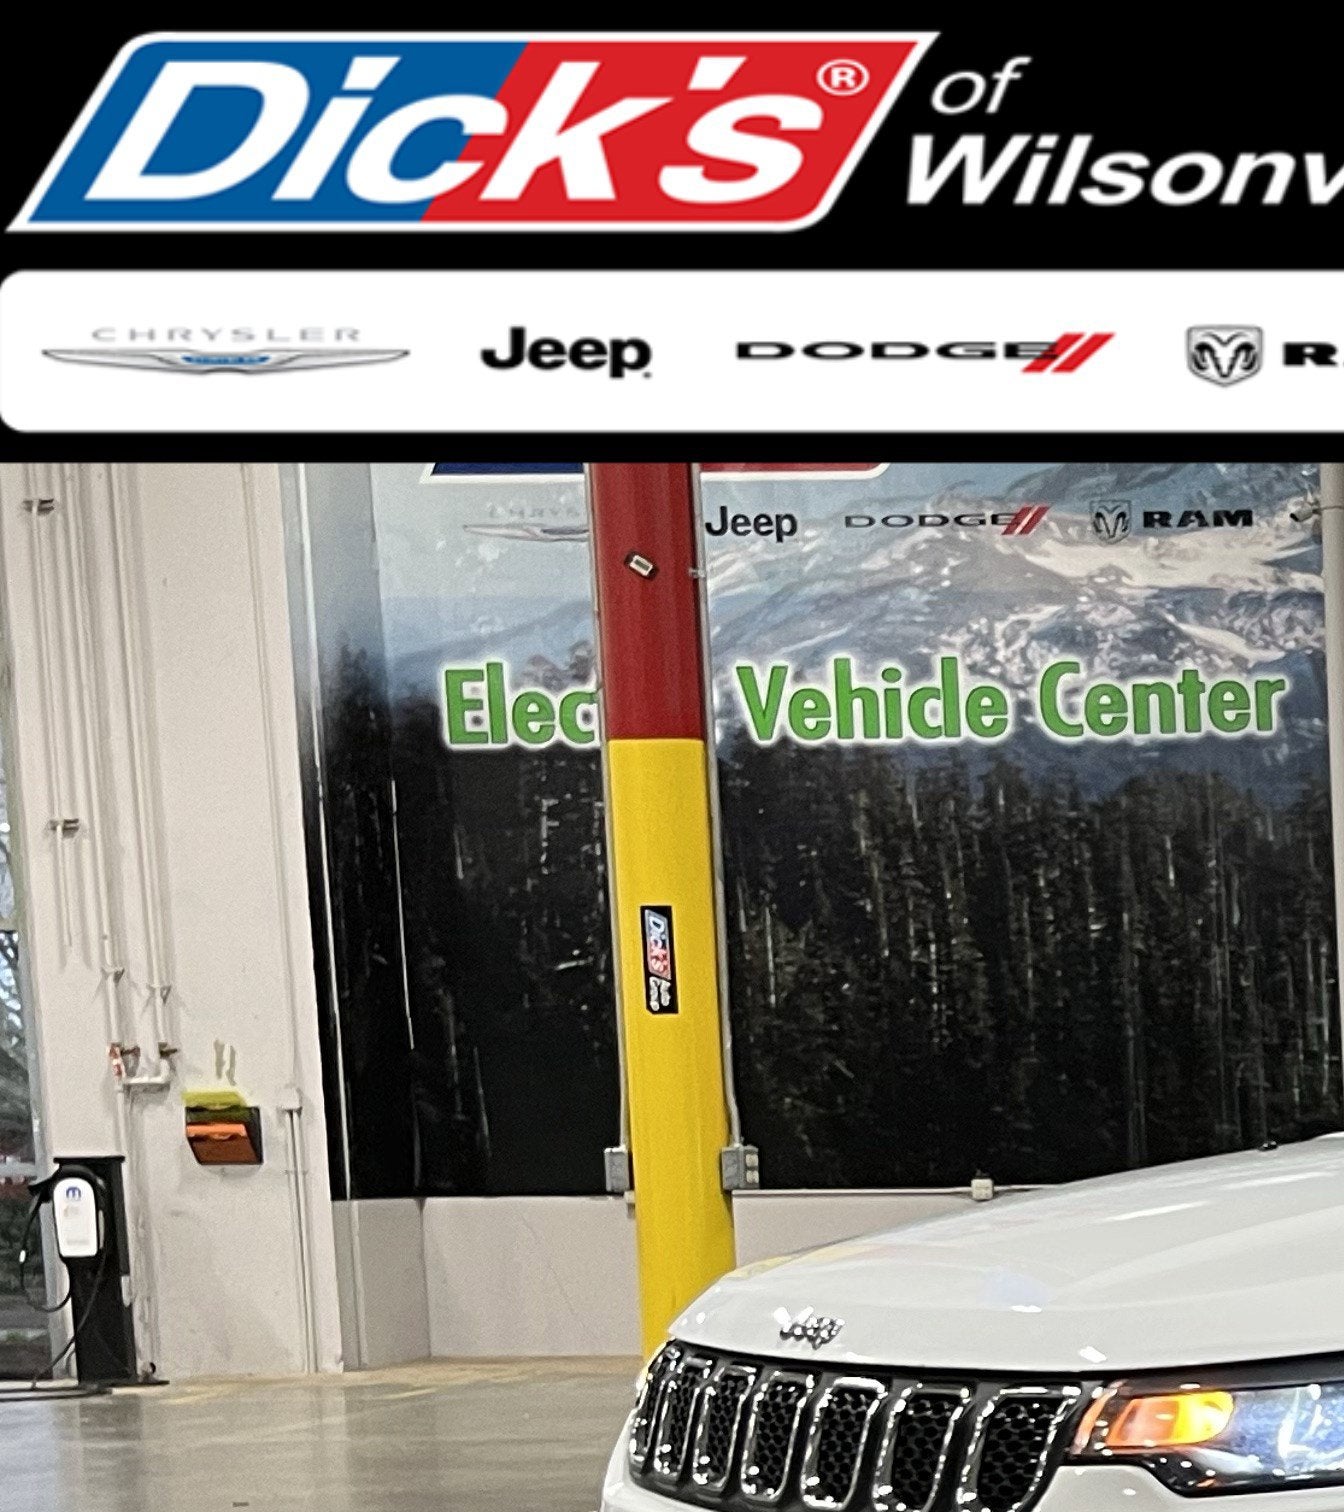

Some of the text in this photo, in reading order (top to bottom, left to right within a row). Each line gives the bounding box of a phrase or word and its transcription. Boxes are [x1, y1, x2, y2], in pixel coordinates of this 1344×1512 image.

[705, 505, 798, 543] Jeep
[1142, 509, 1253, 529] RAM
[444, 656, 1287, 744] Elec Vehicle Center
